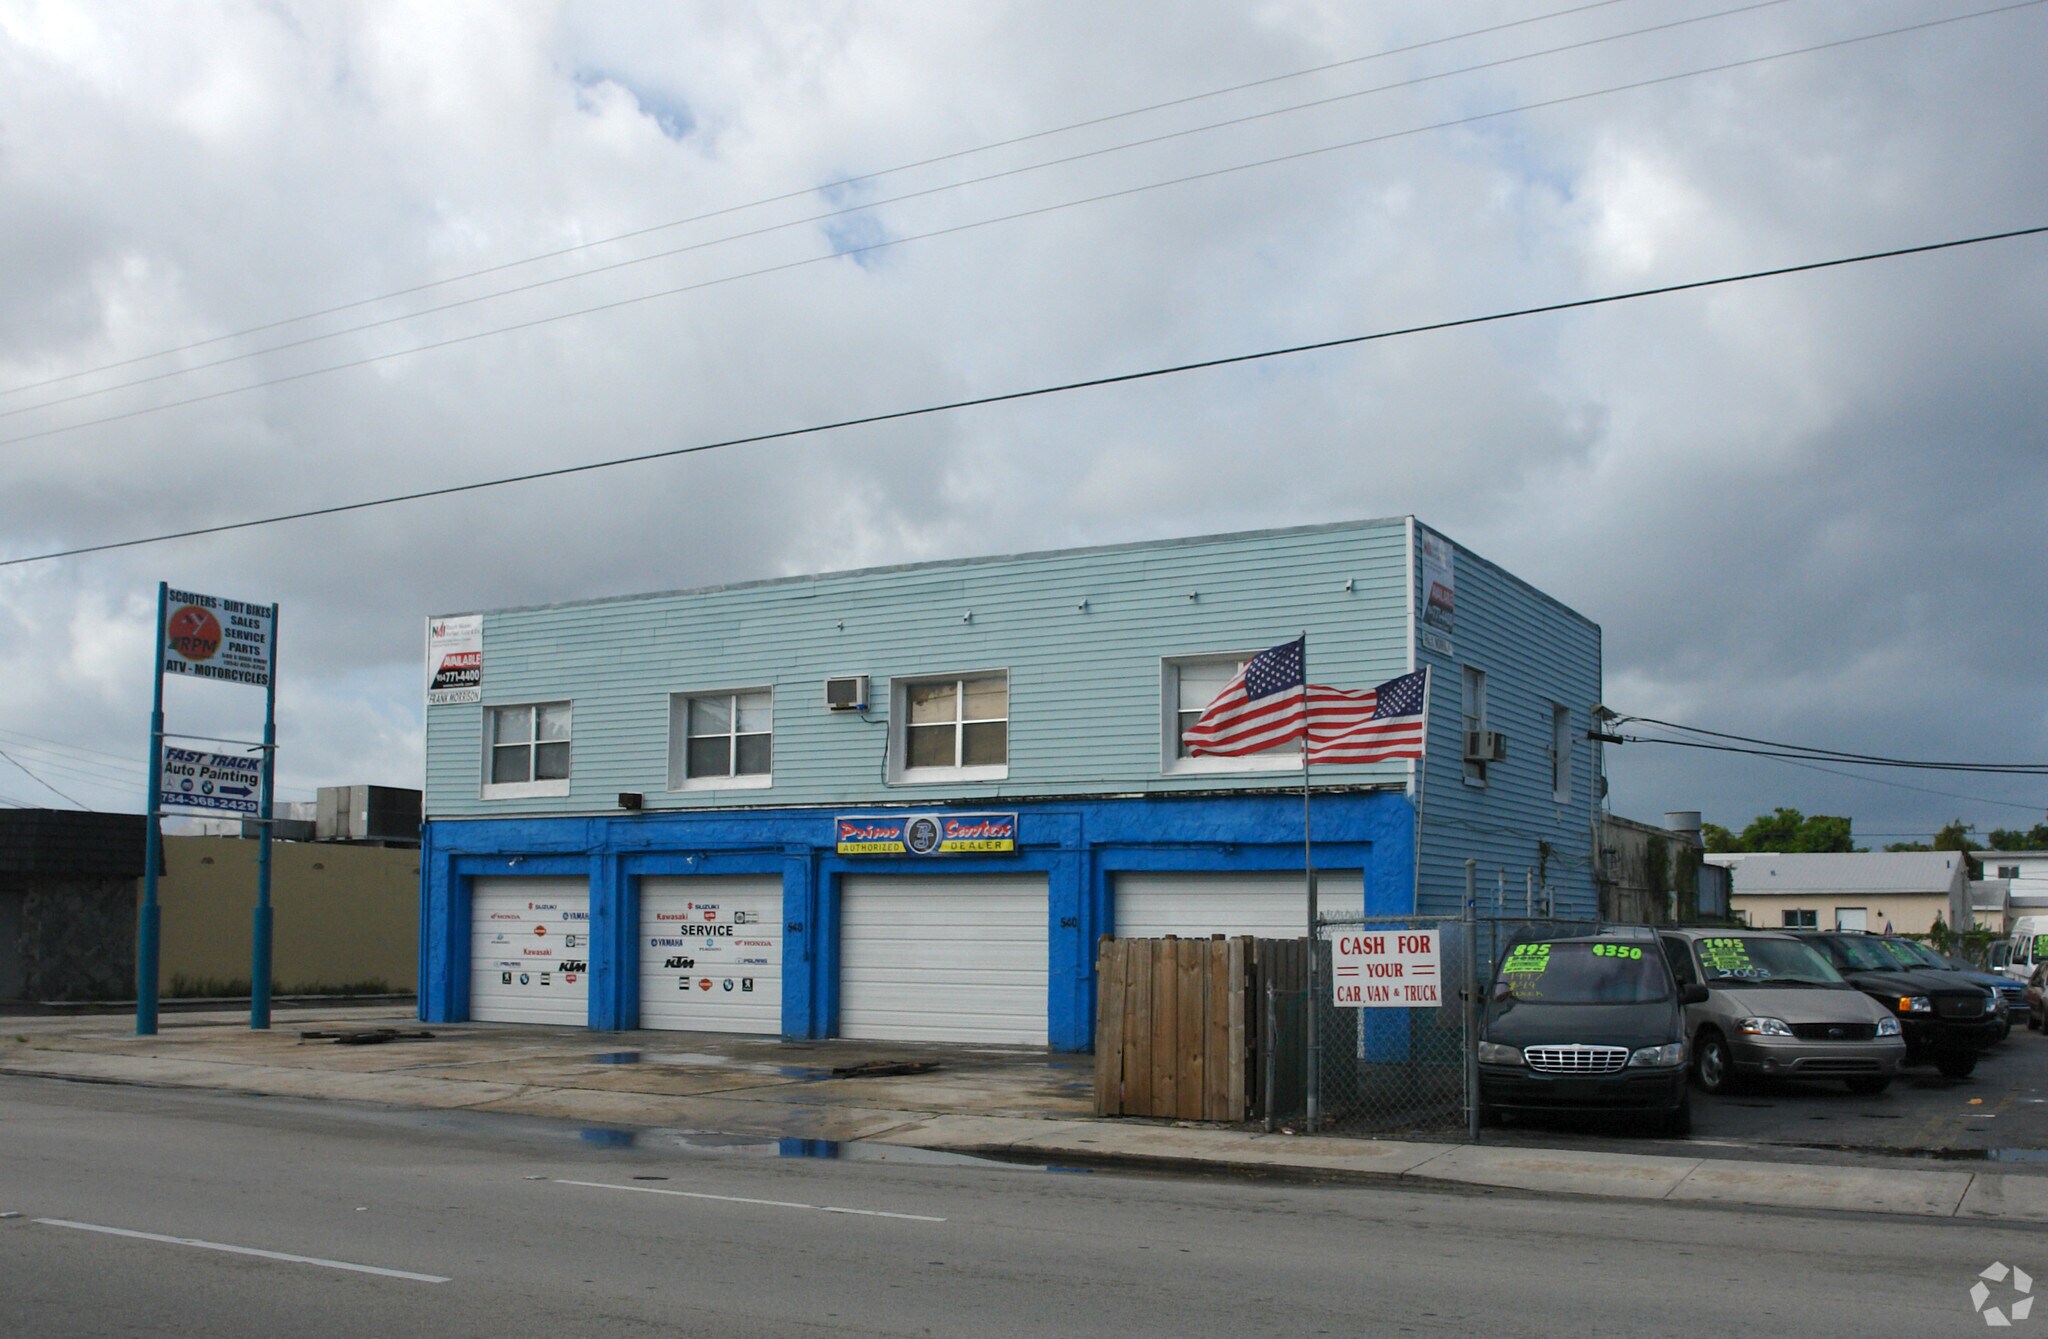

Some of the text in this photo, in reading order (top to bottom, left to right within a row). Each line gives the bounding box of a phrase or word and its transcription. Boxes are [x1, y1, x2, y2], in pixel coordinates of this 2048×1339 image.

[169, 589, 217, 608] SCOOTERS
[224, 600, 245, 614] DIRT
[246, 603, 271, 619] BIKES
[231, 615, 260, 629] SALES
[225, 628, 265, 643] SERVICE
[180, 637, 217, 653] RPM
[229, 642, 260, 656] PARTS
[444, 654, 481, 667] AVAILABLE
[166, 660, 186, 673] ATV
[195, 663, 268, 685] MOTORCYCLES
[428, 693, 449, 704] FRANK
[166, 748, 260, 770] FAST TRACK
[164, 762, 258, 787] Auto Painting
[841, 823, 900, 841] Primo
[843, 840, 1002, 852] AUTHORIZED DEALER
[569, 912, 589, 920] YAMAH
[681, 925, 734, 937] SERVICE
[659, 939, 683, 947] YAMAHA
[1340, 935, 1431, 955] CASH FOR
[1513, 944, 1551, 955] 895
[523, 948, 552, 956] Kawasaki
[1592, 944, 1642, 960] 4350
[559, 960, 587, 972] KTM
[664, 956, 695, 969] KTM
[1366, 963, 1403, 978] YOUR
[1720, 968, 1771, 978] 2003
[1337, 985, 1437, 1002] CAR VAN & TRUCK
